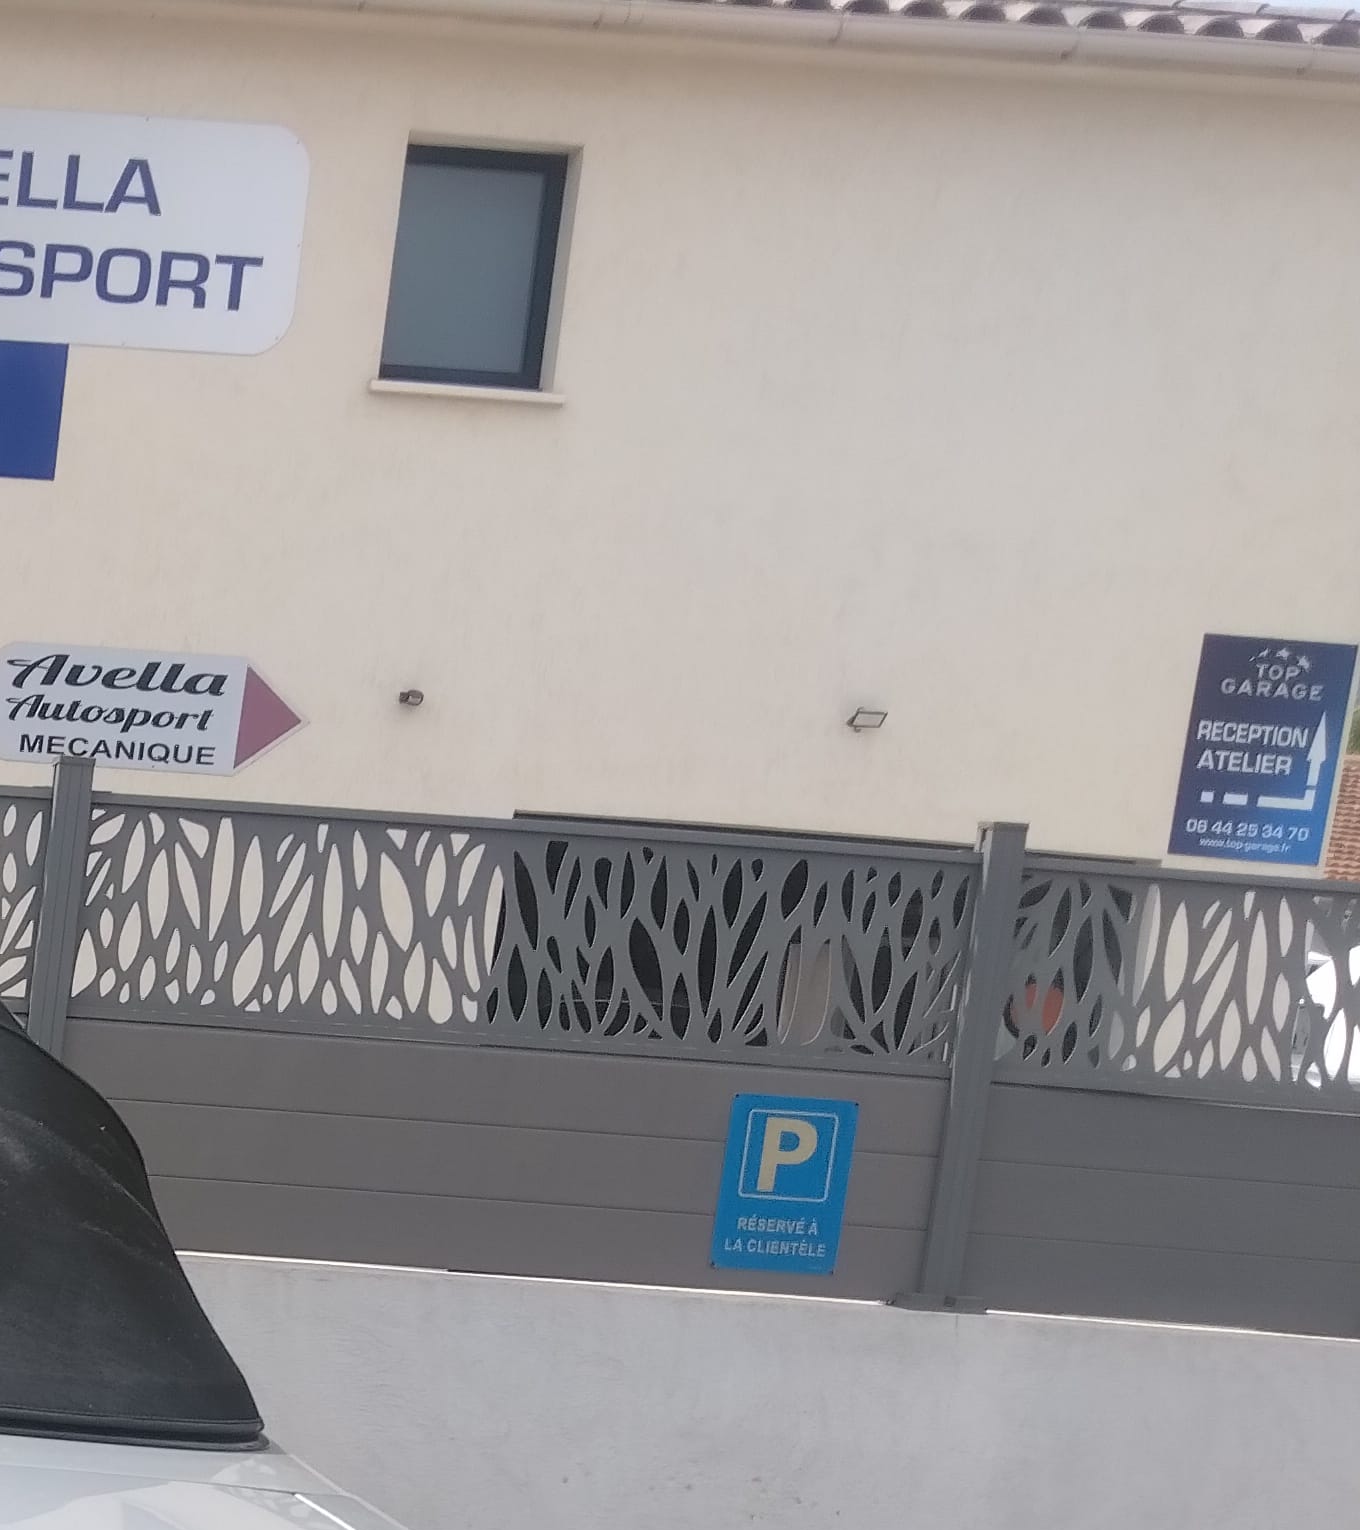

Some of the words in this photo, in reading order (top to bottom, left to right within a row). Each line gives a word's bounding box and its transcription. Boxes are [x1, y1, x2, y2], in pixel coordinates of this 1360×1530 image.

[6, 653, 230, 697] Avella
[1255, 662, 1301, 682] TOP
[1220, 678, 1324, 701] GARAGE
[4, 693, 215, 734] Autosport
[1197, 719, 1310, 749] RECEPTION
[18, 733, 217, 766] MECANIQUE
[1196, 749, 1293, 776] ATELIER
[1186, 819, 1208, 833] 06
[1211, 821, 1232, 835] 44
[1261, 824, 1284, 838] 34
[1287, 827, 1310, 841] 70
[756, 1117, 819, 1193] P
[737, 1214, 806, 1235] RÉSERVÉ
[724, 1238, 743, 1252] LA
